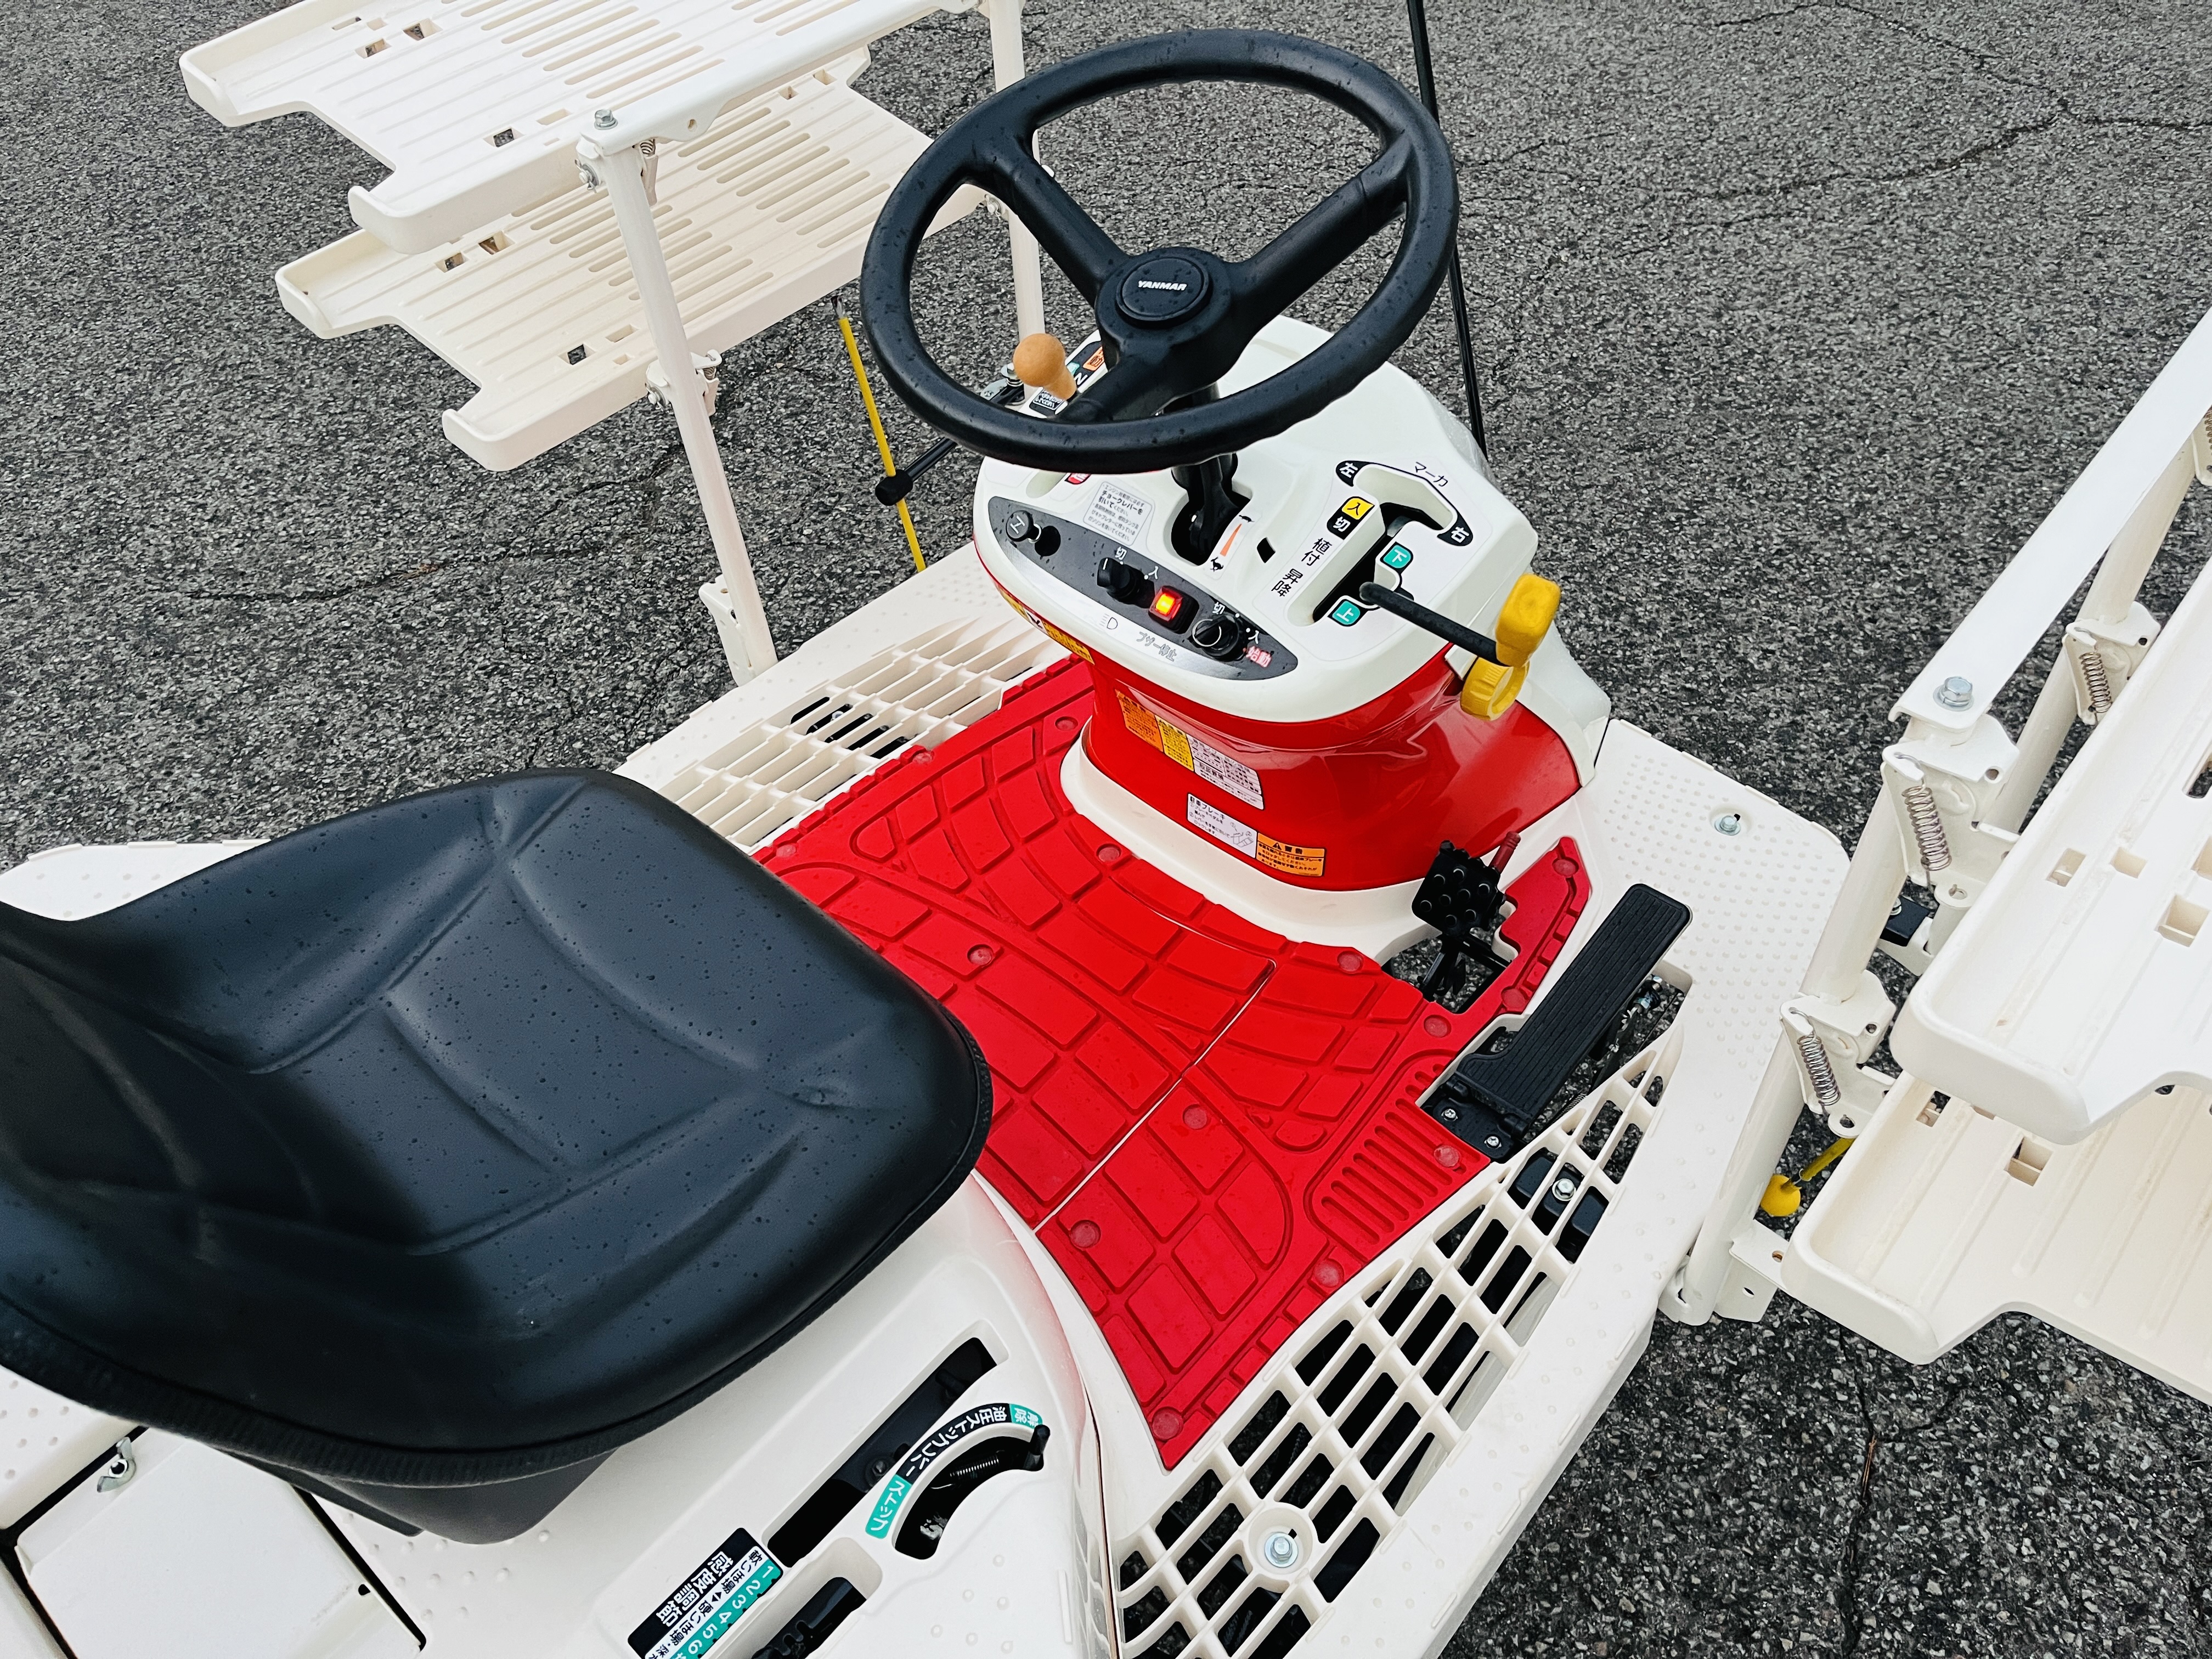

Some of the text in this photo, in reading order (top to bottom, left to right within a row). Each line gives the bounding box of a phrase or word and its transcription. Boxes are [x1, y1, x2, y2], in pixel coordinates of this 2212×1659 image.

[1138, 280, 1187, 291] YANMAR
[1074, 372, 1088, 386] N
[1339, 462, 1358, 478] 左
[1414, 461, 1449, 487] マーカ
[1347, 502, 1366, 516] 入
[1333, 516, 1351, 532] 切
[1451, 526, 1470, 543] 右
[1114, 546, 1128, 561] 切
[1392, 549, 1408, 563] 下
[1148, 566, 1159, 579] 入
[1271, 538, 1333, 597] 植付 昇降
[1212, 602, 1225, 615] 切
[1336, 607, 1355, 622] 上
[1248, 630, 1260, 644] 入
[1136, 631, 1178, 662] ブザー停止
[1246, 645, 1273, 668] 始動
[906, 1406, 1007, 1477] 油圧ストップレバー
[870, 1480, 905, 1531] ストップ
[656, 1551, 734, 1628] 感度調節
[688, 1566, 774, 1654] 1 2 3 4 5 6
